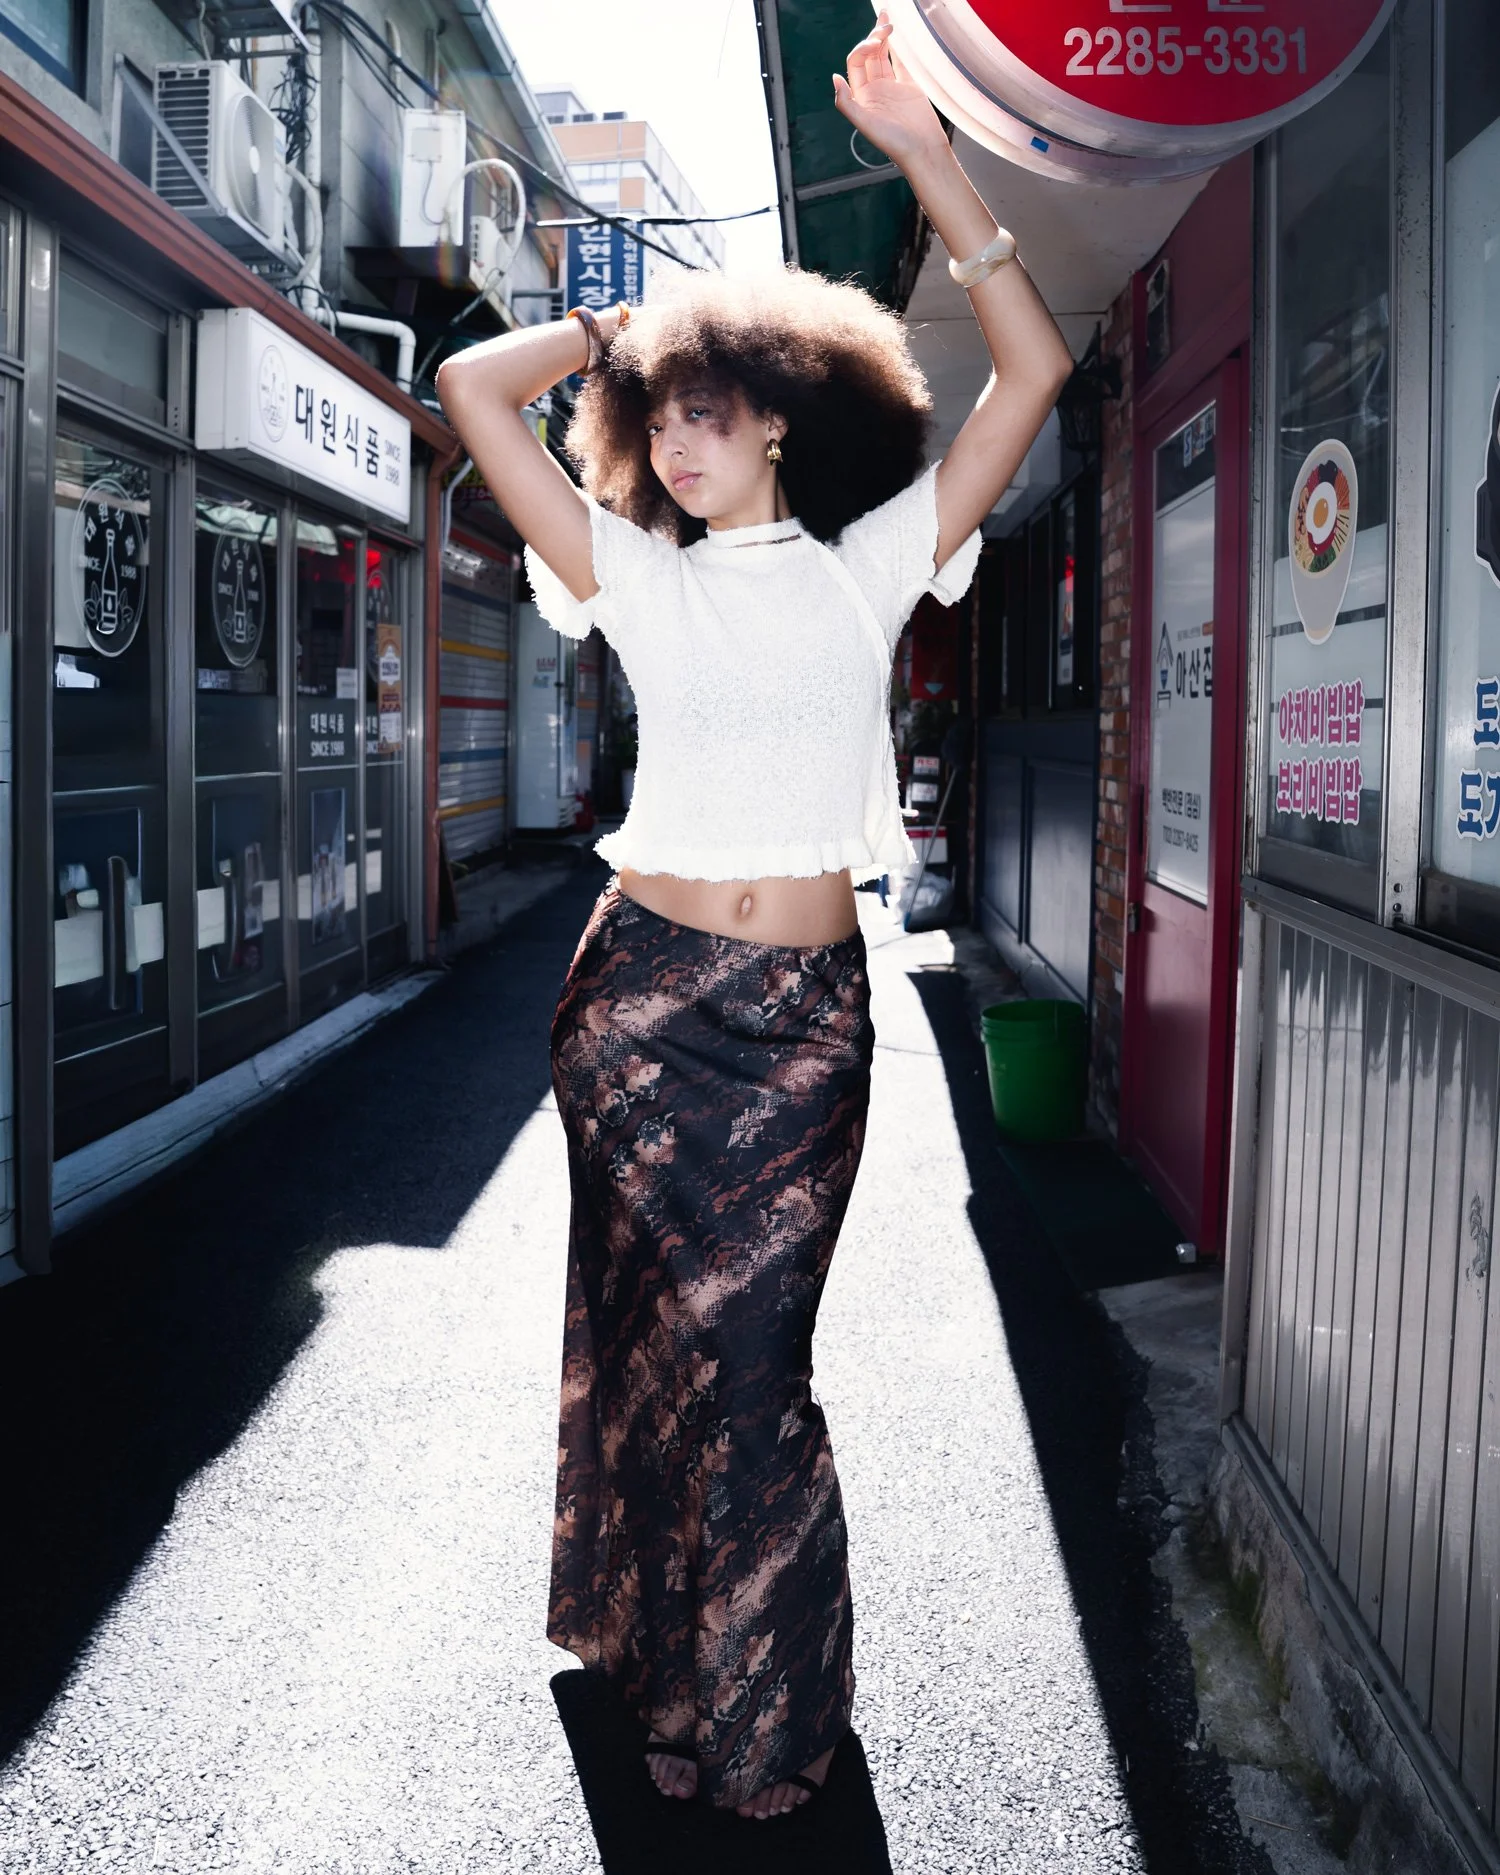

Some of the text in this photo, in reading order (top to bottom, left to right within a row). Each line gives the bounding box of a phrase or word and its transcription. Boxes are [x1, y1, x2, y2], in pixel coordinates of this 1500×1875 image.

[1064, 26, 1307, 76] 2285-3331
[295, 384, 380, 479] 대원식품
[1279, 678, 1365, 747] 야채비빔밥
[1277, 756, 1362, 824] 보리비빔밥
